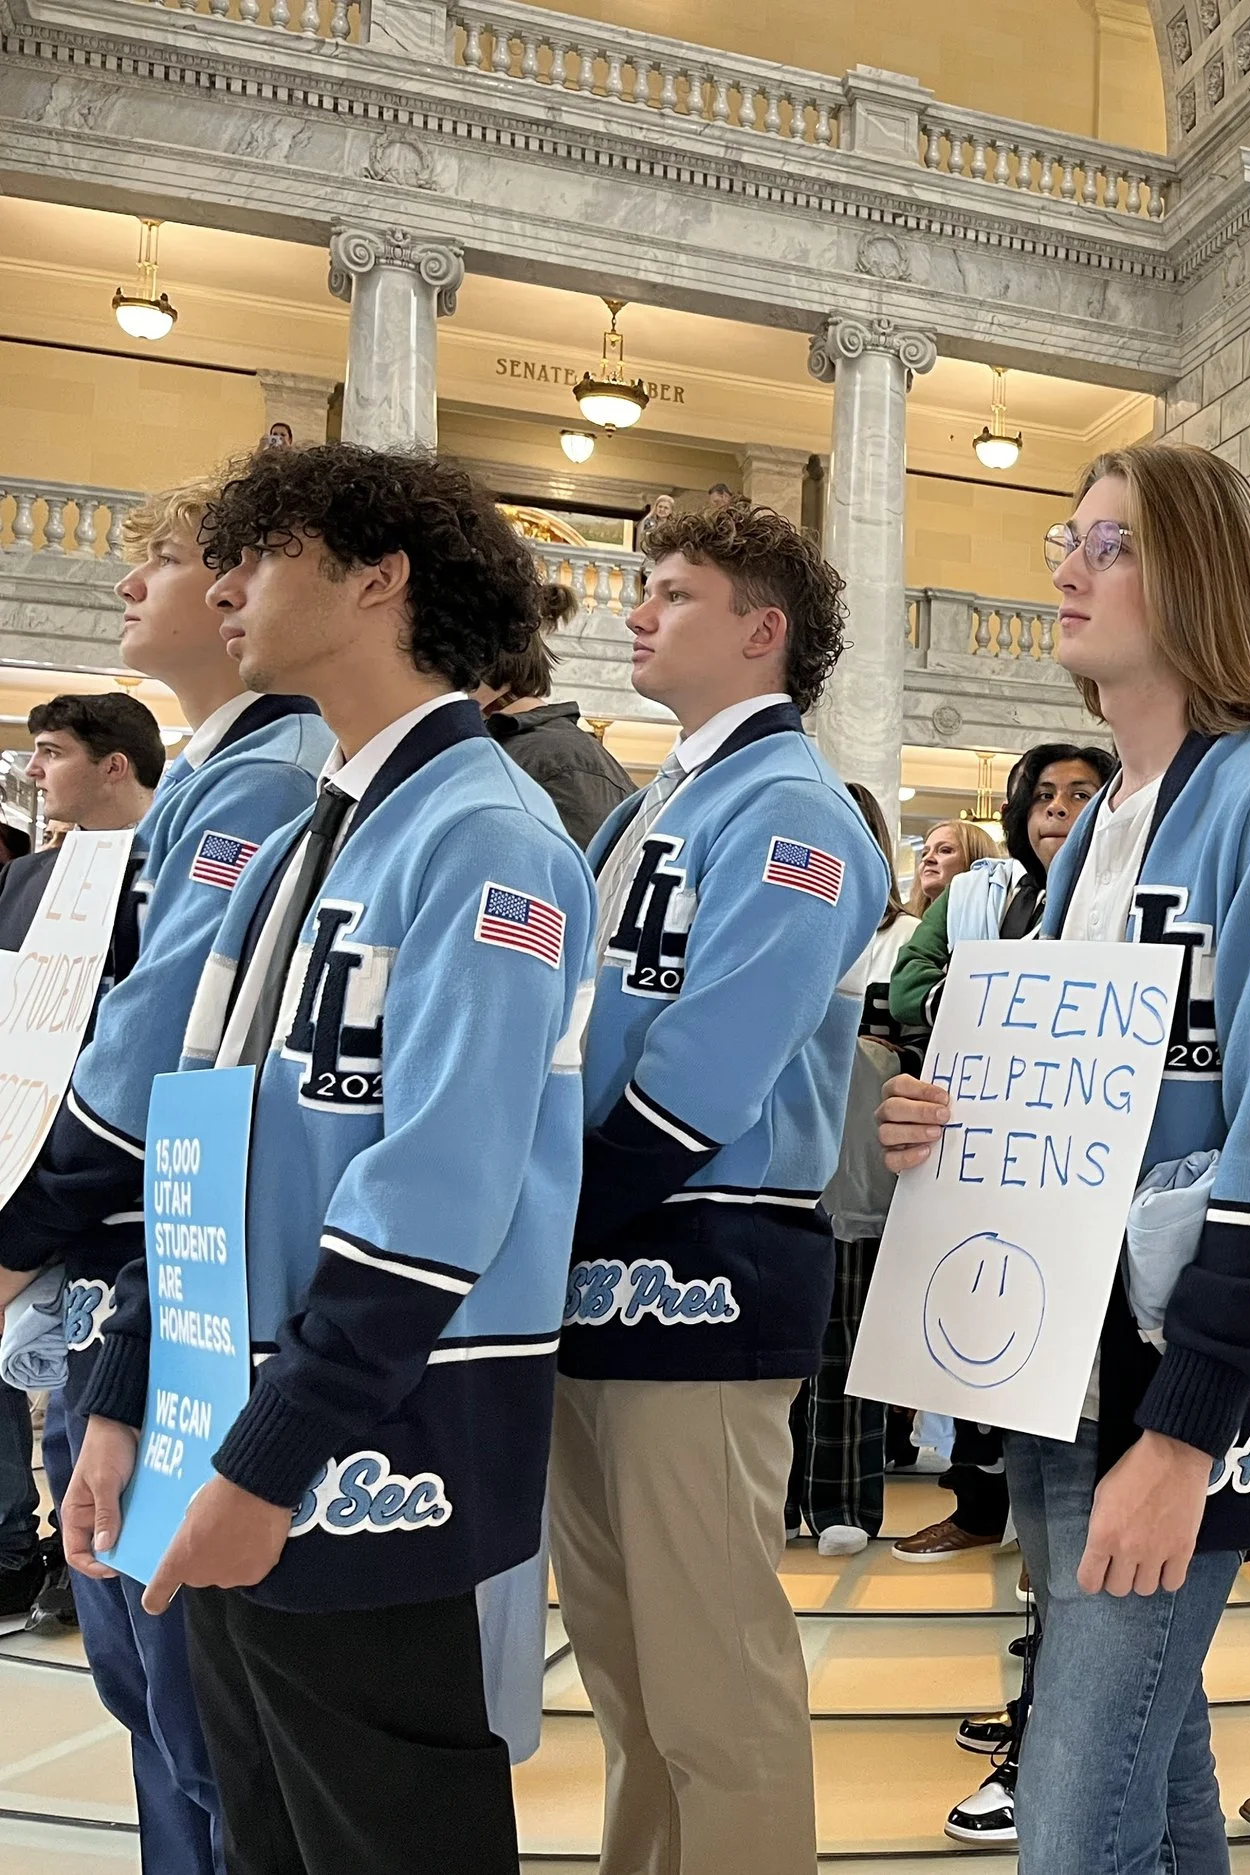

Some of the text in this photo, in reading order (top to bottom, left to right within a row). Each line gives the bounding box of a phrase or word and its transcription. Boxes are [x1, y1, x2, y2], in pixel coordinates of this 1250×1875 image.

[494, 358, 577, 386] SENATE
[638, 966, 681, 989] 20
[969, 971, 1169, 1046] TEENS
[316, 1072, 384, 1099] 202
[930, 1051, 1136, 1115] HELPING
[155, 1138, 201, 1179] 15,000
[935, 1121, 1111, 1189] TEENS
[154, 1180, 192, 1218] UTAH
[155, 1222, 228, 1266] STUDENTS
[158, 1263, 184, 1300] ARE
[630, 1263, 736, 1319] Pres.
[159, 1304, 237, 1357] HOMELESS.
[156, 1388, 213, 1441] WE CAN
[144, 1431, 185, 1480] HELP.
[326, 1457, 446, 1528] Sec.
